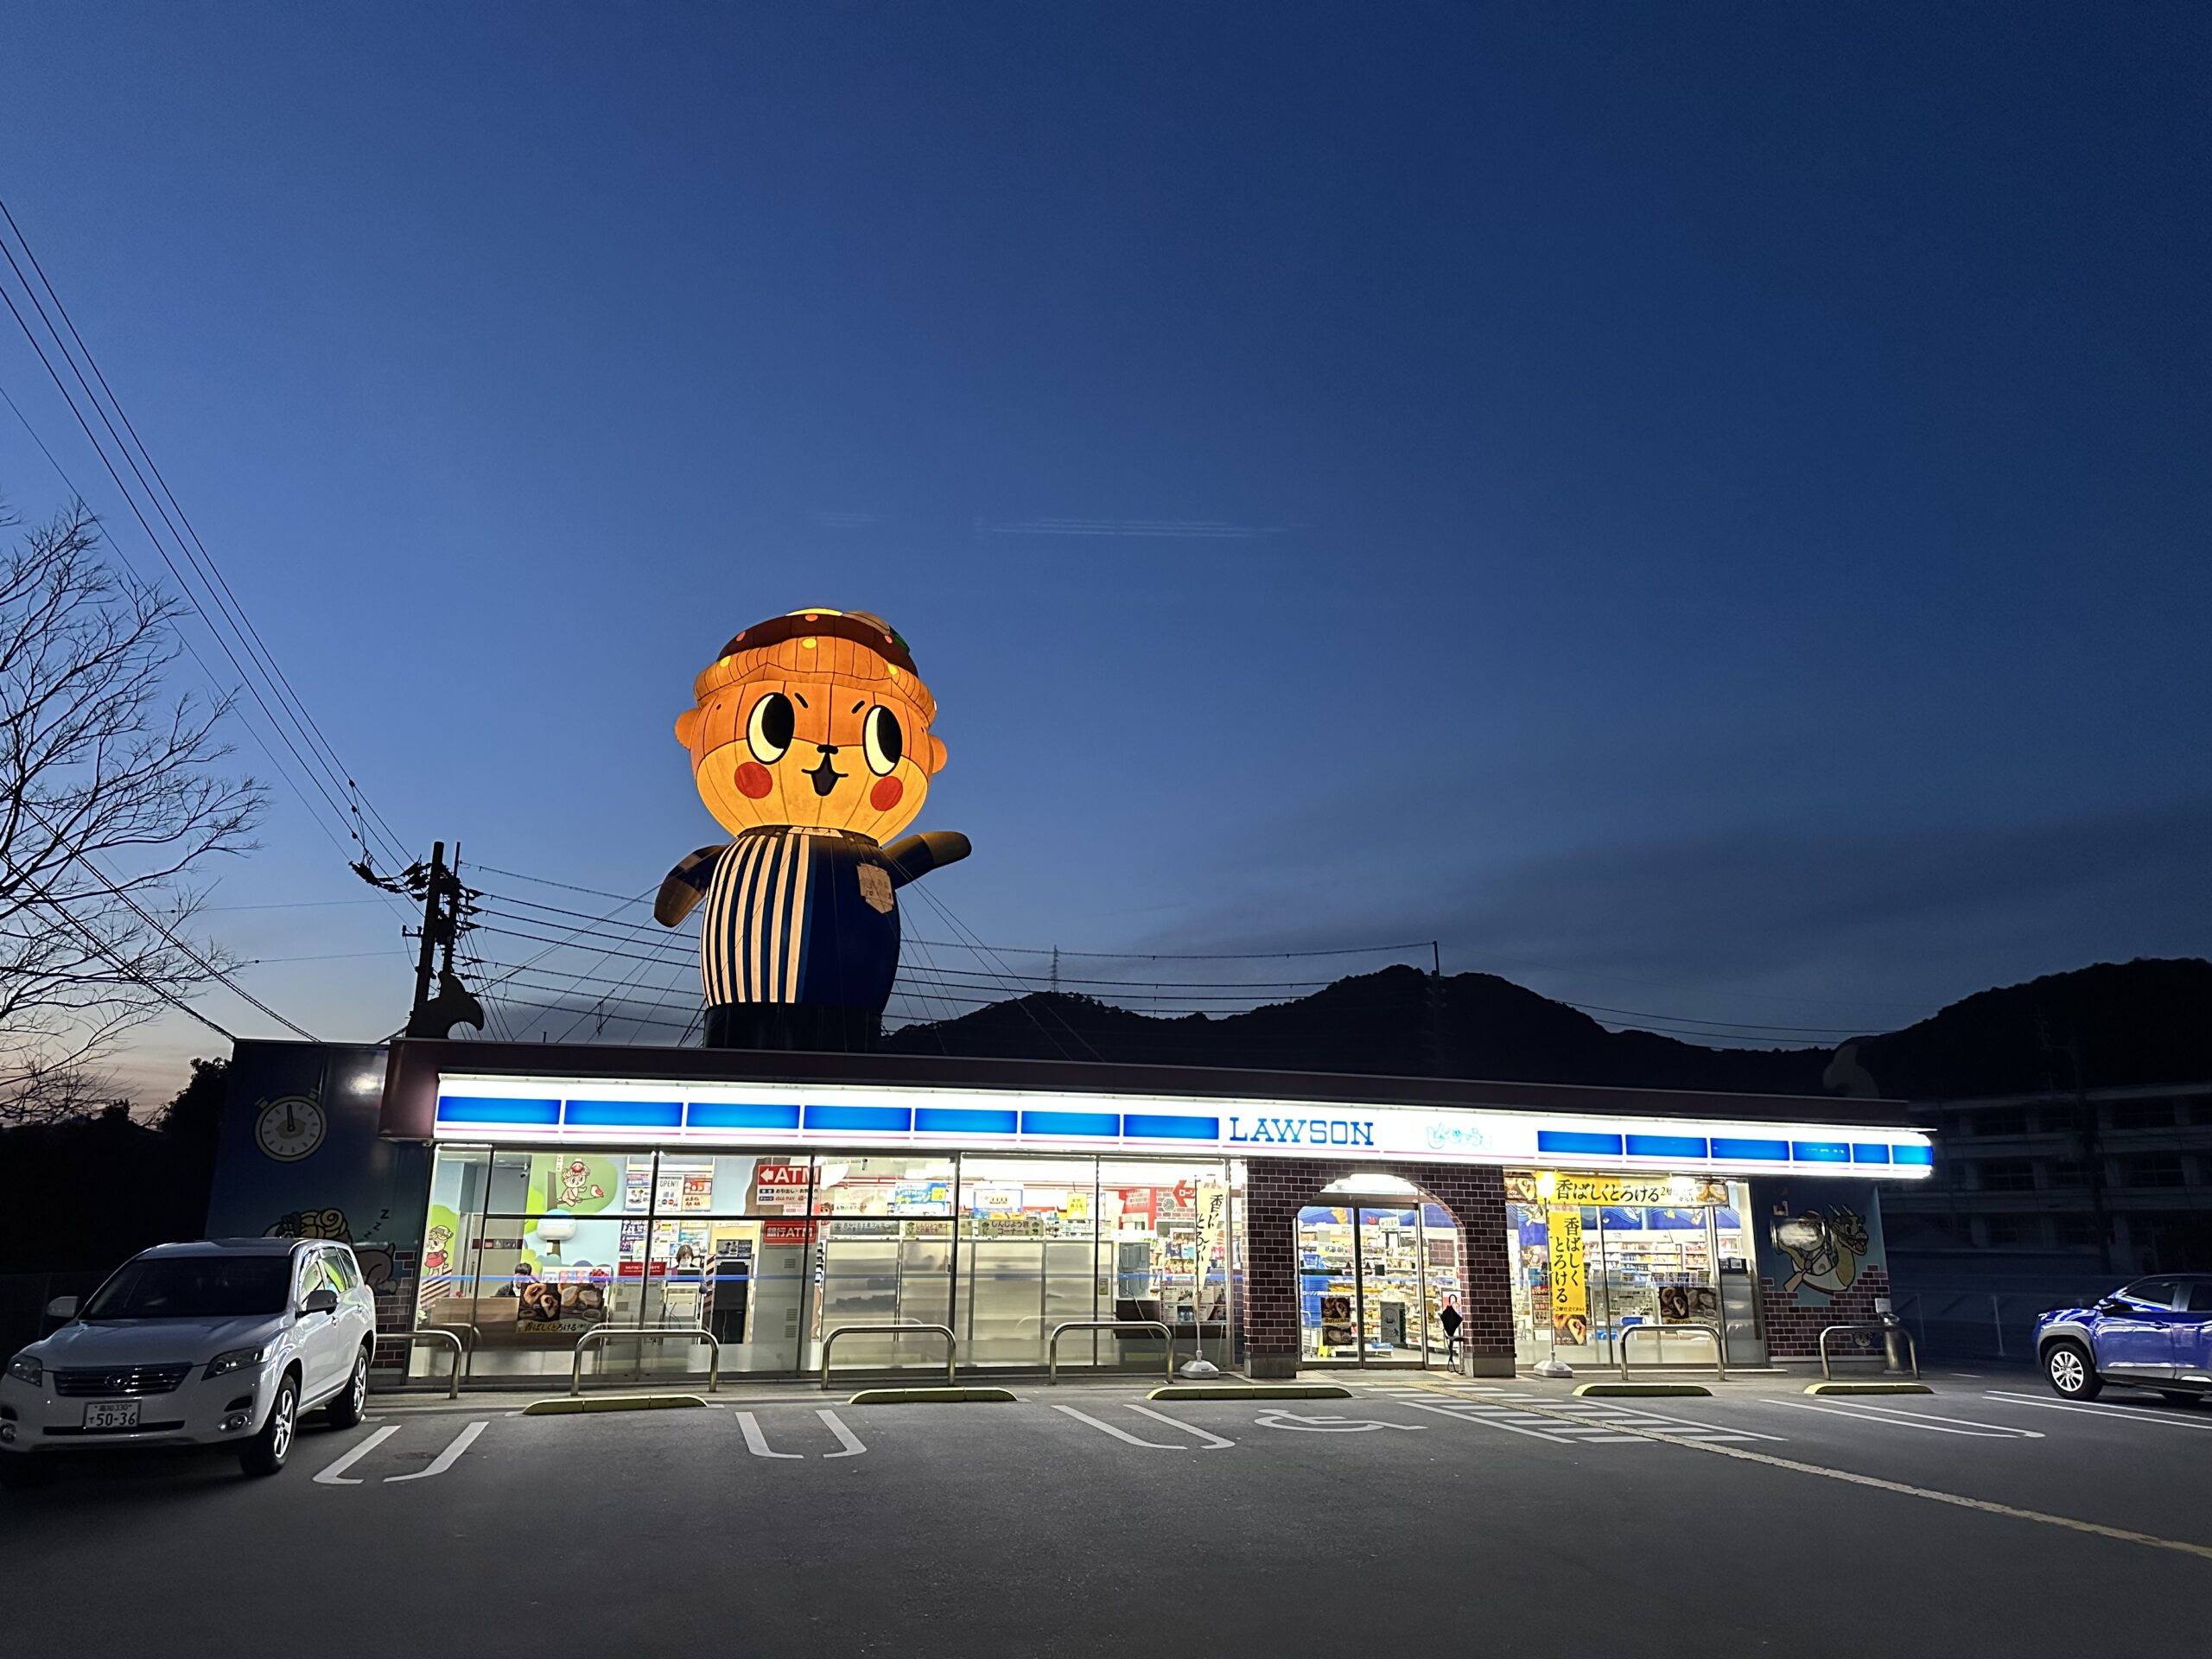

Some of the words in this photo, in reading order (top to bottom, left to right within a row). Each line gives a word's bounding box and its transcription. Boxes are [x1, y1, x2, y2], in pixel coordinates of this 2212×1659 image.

[1229, 1116, 1375, 1146] LAWSON
[774, 1167, 819, 1183] ATM
[1555, 1179, 1660, 1203] 香ばしくとろける
[766, 1227, 812, 1237] 銀行ATM
[1564, 1217, 1580, 1287] 香ばしく
[1554, 1236, 1568, 1303] とろける
[96, 1412, 137, 1426] 50-36
